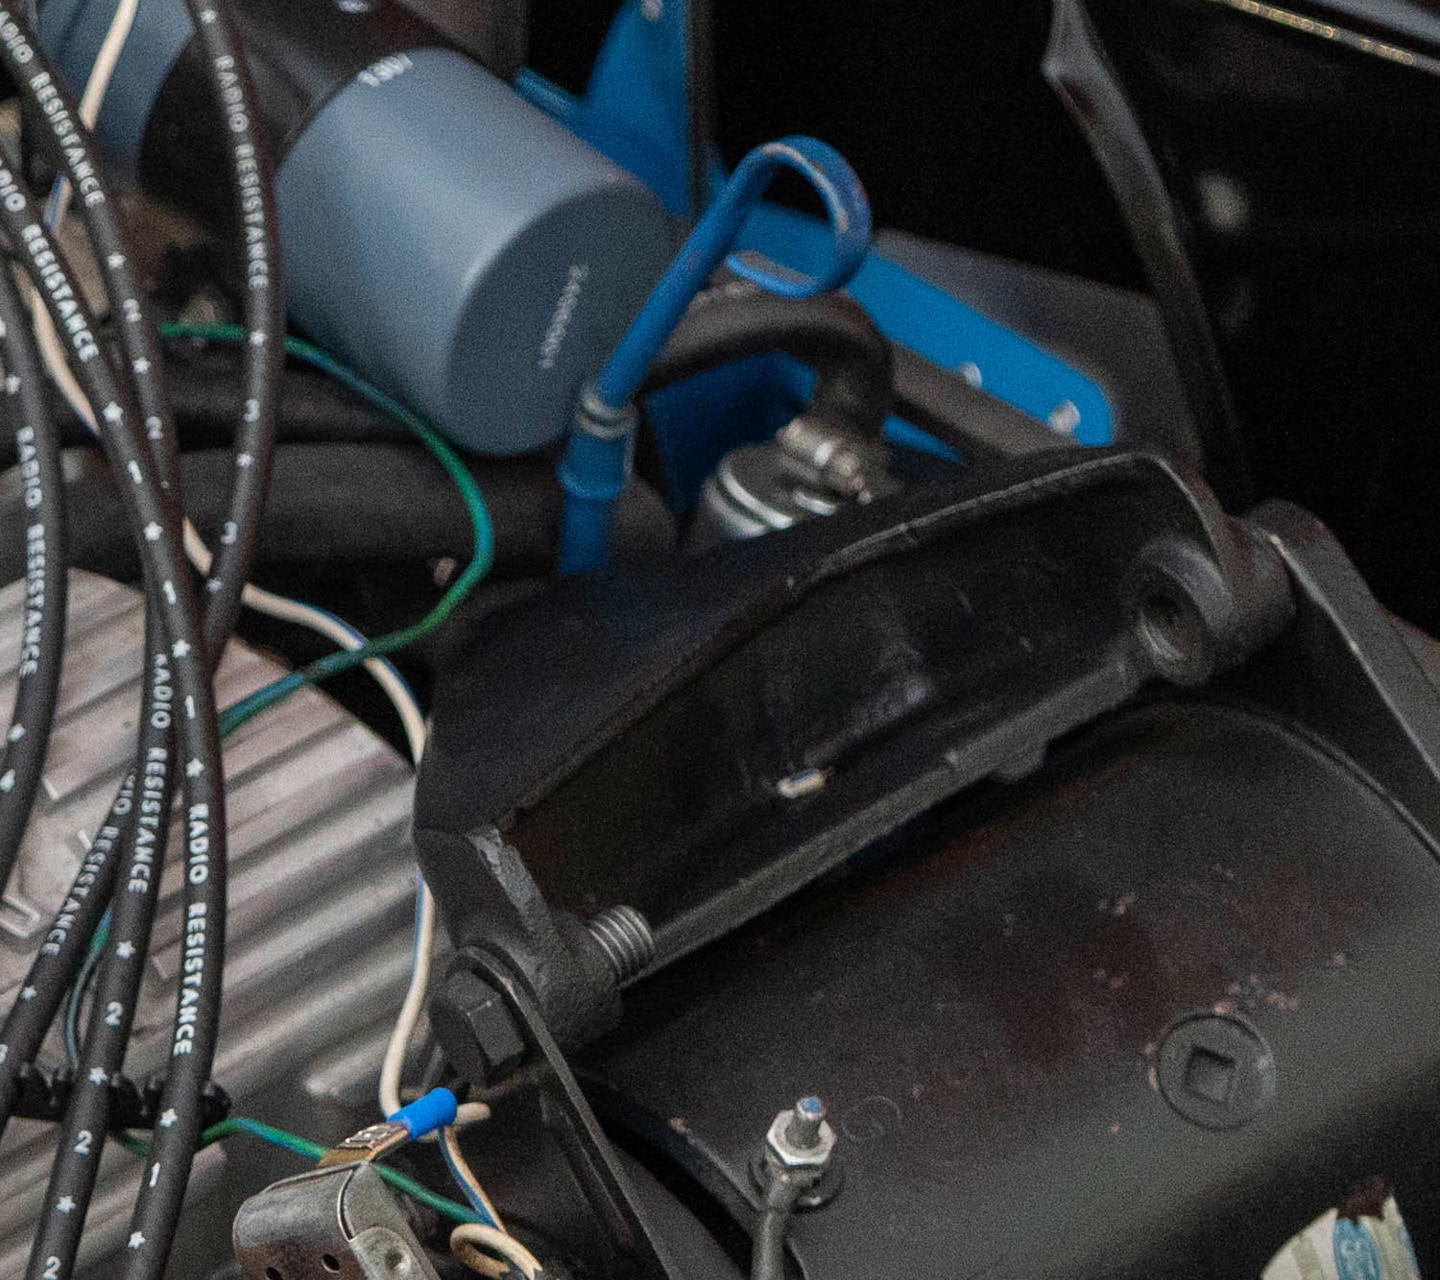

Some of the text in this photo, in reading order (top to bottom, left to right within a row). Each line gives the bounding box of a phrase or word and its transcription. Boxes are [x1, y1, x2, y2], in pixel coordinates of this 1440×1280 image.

[29, 71, 107, 208] RESISTANCE
[215, 55, 249, 133] RADIO
[233, 144, 269, 292] RESISTANCE
[21, 223, 100, 363] RESISTANCE
[18, 424, 43, 510] RADIO
[20, 522, 46, 679] RESISTANCE
[151, 653, 174, 730] RADIO
[128, 746, 168, 895] RESISTANCE
[188, 802, 209, 887] RADIO
[41, 825, 120, 957] RESISTANCE
[105, 1001, 124, 1027] 2
[172, 902, 208, 1057] RESISTANCE
[74, 1129, 93, 1155] 2
[150, 1162, 162, 1188] 1
